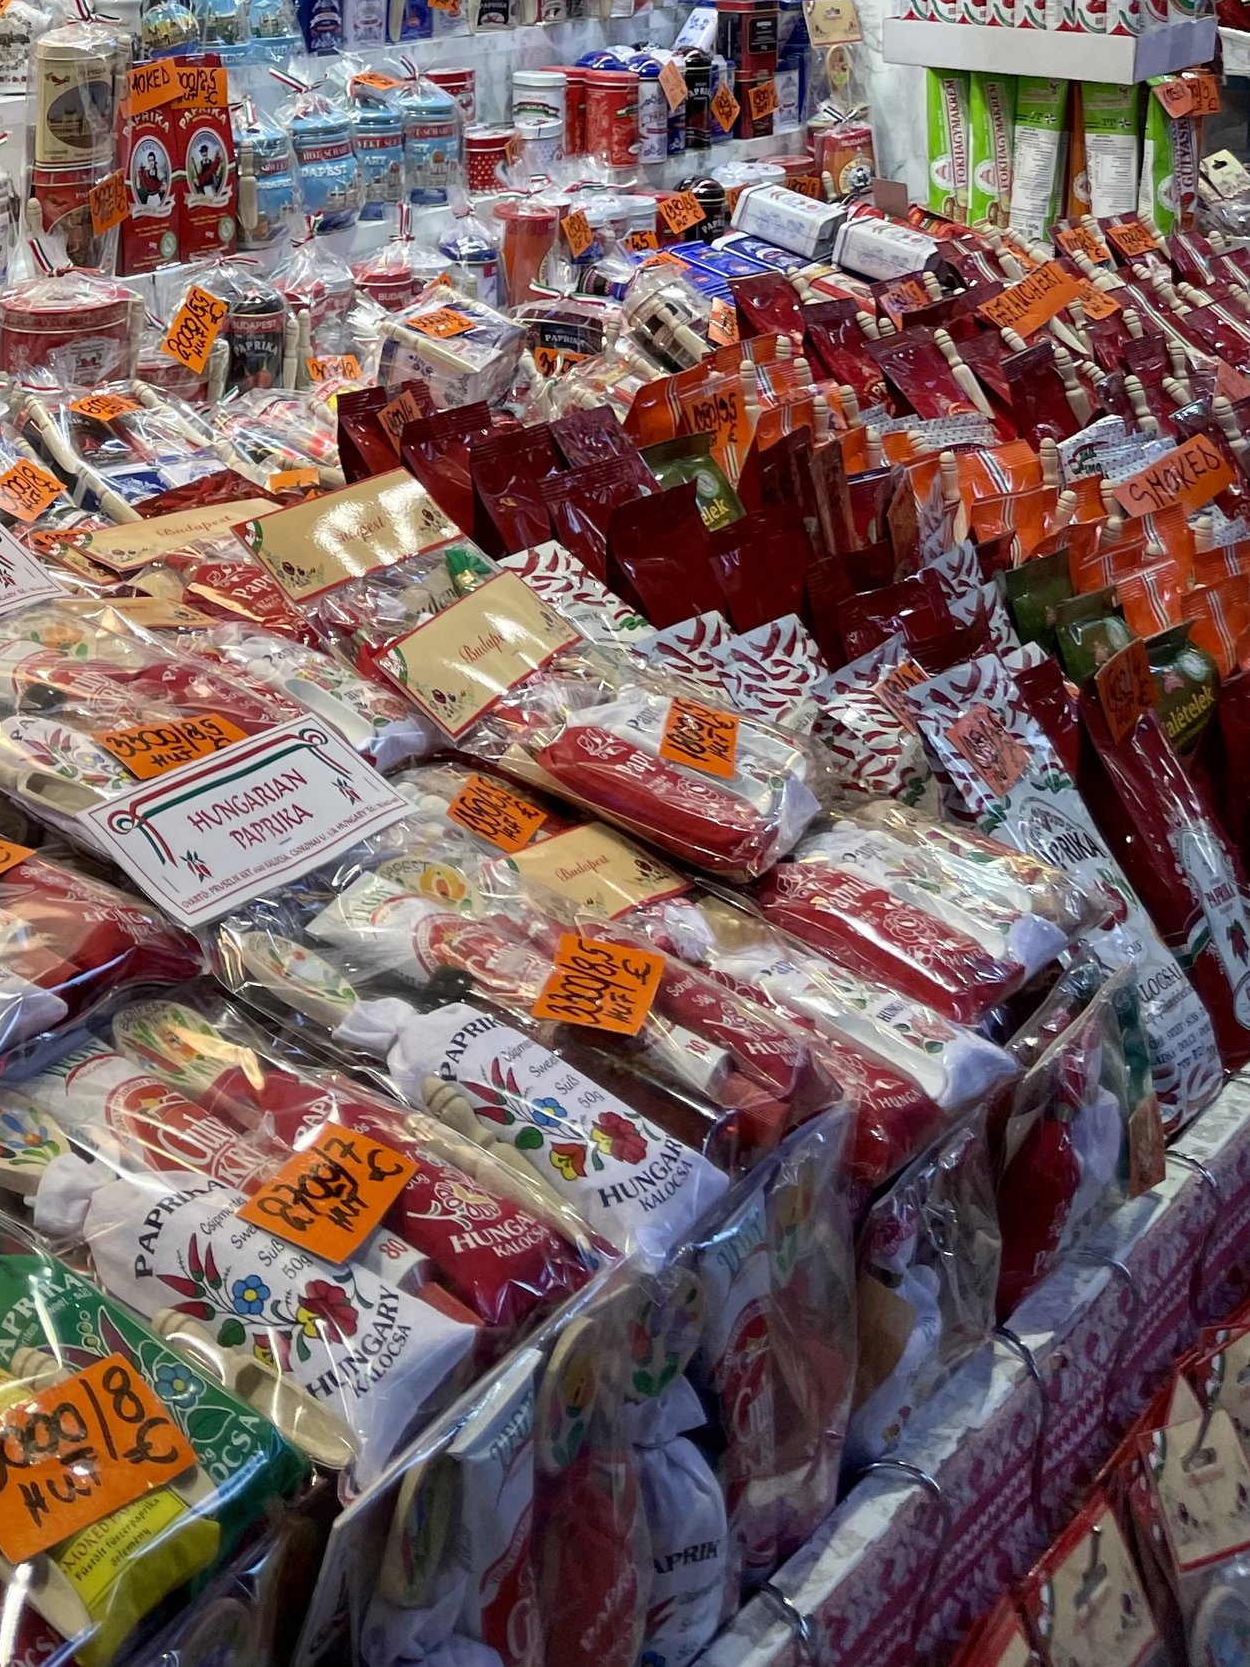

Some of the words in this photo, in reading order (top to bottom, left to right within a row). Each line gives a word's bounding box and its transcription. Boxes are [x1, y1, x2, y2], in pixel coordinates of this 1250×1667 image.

[122, 108, 171, 136] PAPRIKA
[230, 319, 276, 331] BUDAPEST
[233, 341, 279, 357] PAPRIKA
[149, 745, 195, 767] HUF
[187, 768, 308, 833] HUNGARIAN
[229, 803, 314, 850] PAPRIKA
[554, 852, 611, 883] Budapest
[555, 1074, 581, 1096] Süß
[580, 1090, 607, 1112] 50g
[637, 1157, 695, 1213] KALOCSA
[135, 1179, 229, 1279] PAPRIKA
[258, 1238, 286, 1268] Süß
[281, 1254, 314, 1281] 50g
[305, 1287, 403, 1399] HUNGARY
[350, 1324, 414, 1399] KALOCSA
[19, 1462, 106, 1530] HUF
[122, 1415, 181, 1469] €
